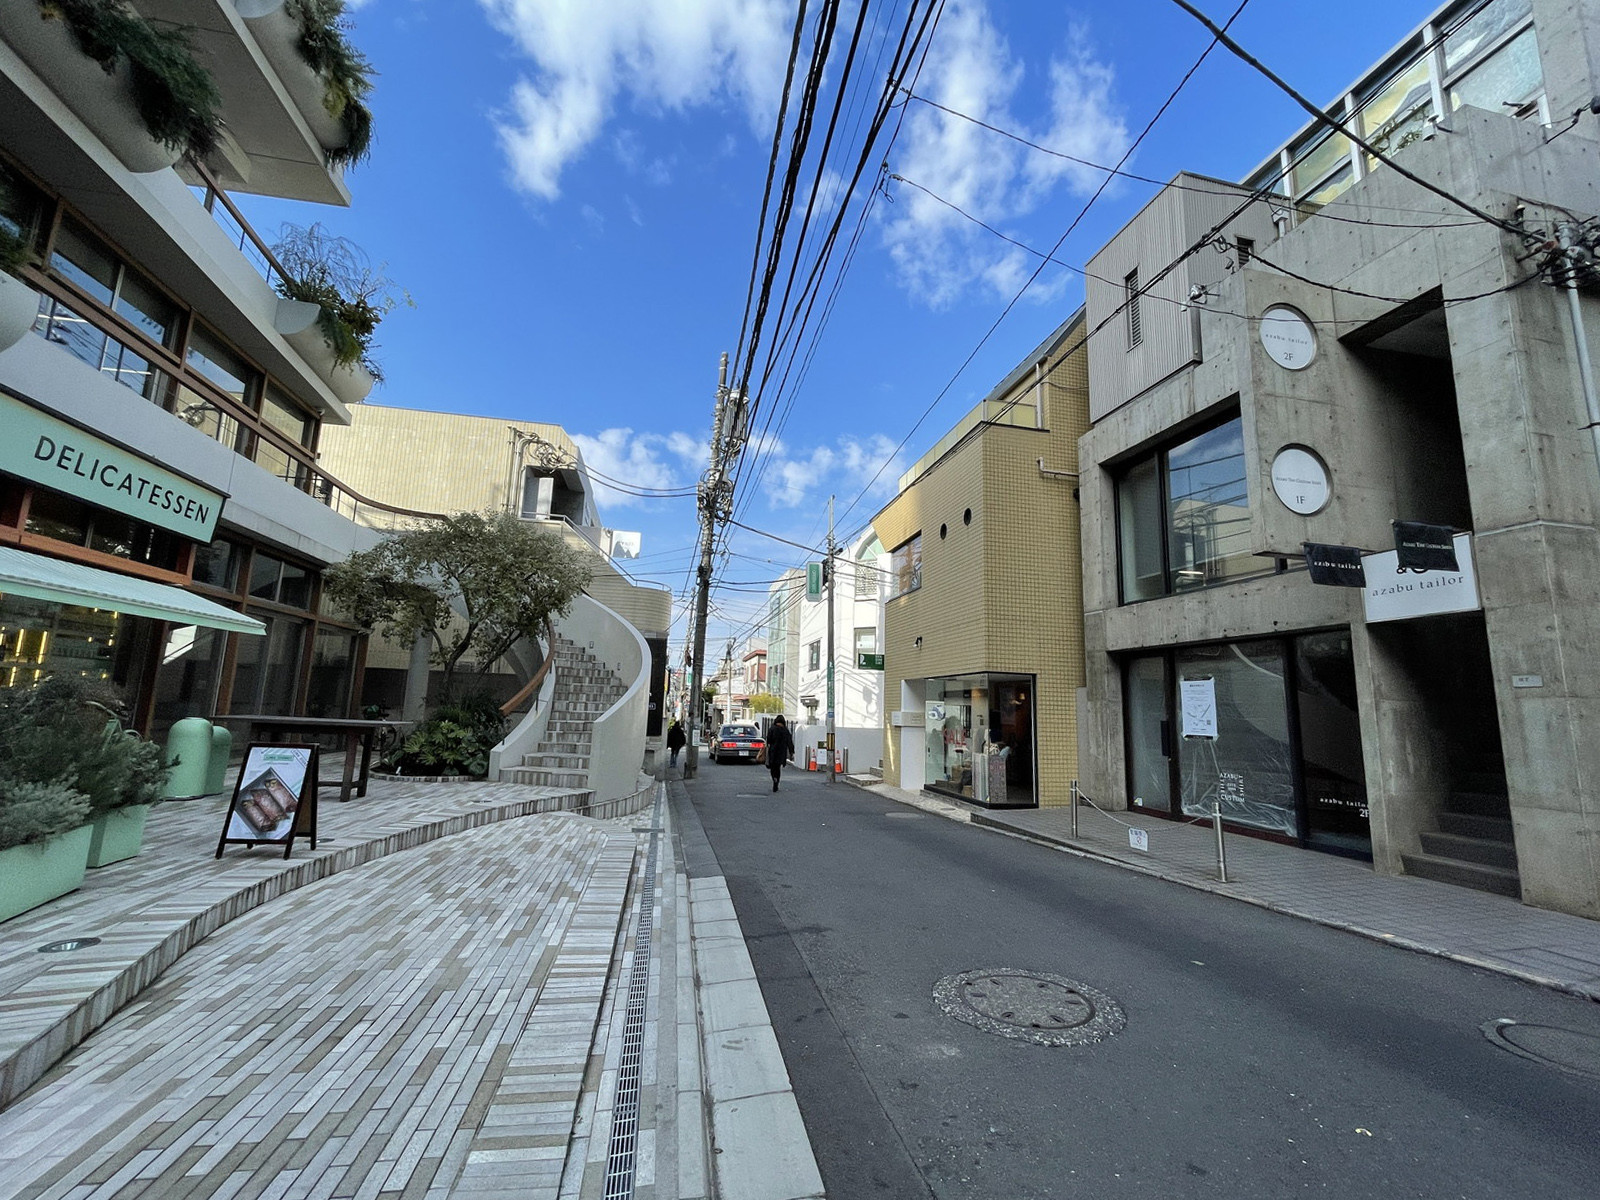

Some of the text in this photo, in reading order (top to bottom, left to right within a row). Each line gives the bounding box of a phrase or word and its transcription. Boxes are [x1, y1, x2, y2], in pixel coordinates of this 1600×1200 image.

[1283, 351, 1294, 361] 2F
[34, 435, 210, 524] DELICATESSEN
[1296, 495, 1305, 504] 1F
[1372, 575, 1464, 597] azabu tailor
[1346, 800, 1369, 808] tailo
